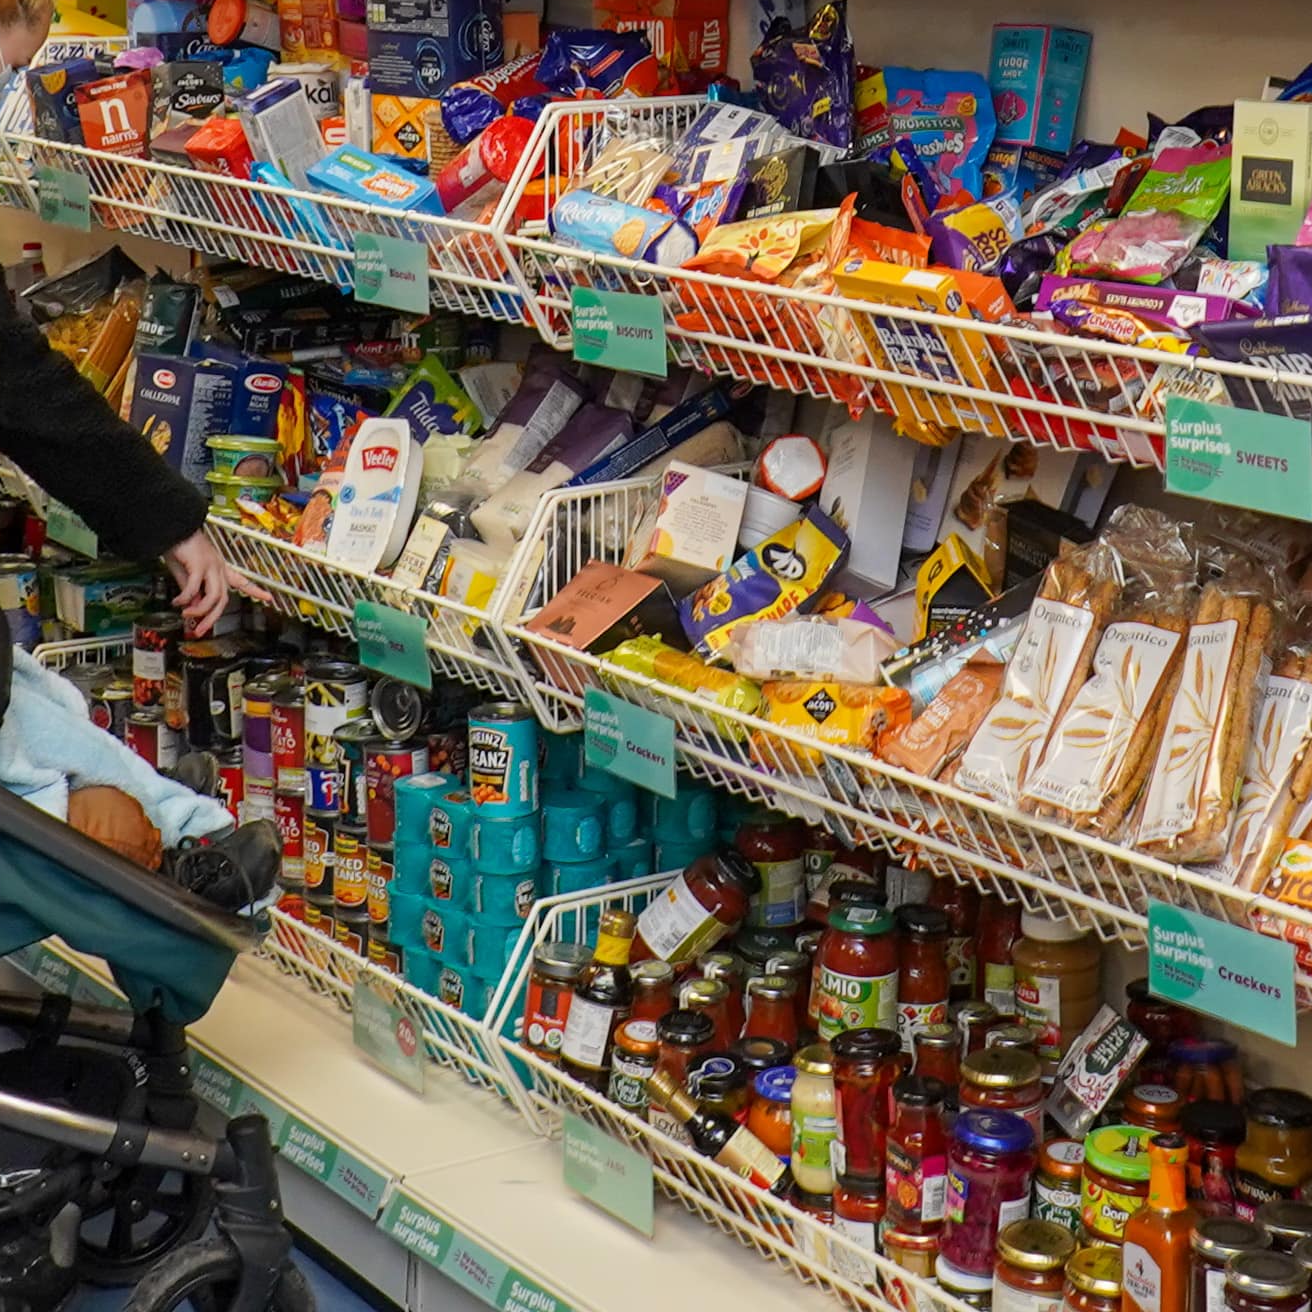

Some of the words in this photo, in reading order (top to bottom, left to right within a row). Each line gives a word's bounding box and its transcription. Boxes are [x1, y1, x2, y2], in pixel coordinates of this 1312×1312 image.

[701, 19, 721, 71] OATIES
[998, 55, 1029, 70] FUDGE
[98, 97, 131, 135] n
[892, 114, 962, 131] DRUMSTICK
[101, 128, 140, 147] nairn's
[560, 199, 595, 224] Rich
[574, 304, 608, 321] Surplus
[575, 316, 615, 334] surprises
[1089, 313, 1135, 337] Crunchie
[616, 325, 654, 341] BISCUITS
[408, 390, 441, 432] Tilda
[1170, 419, 1223, 437] Surplus
[1170, 434, 1231, 456] surprises
[362, 447, 396, 471] VeeTee
[1236, 449, 1289, 473] SWEETS
[1033, 603, 1082, 631] Organico
[1104, 627, 1170, 649] Organico
[625, 739, 666, 768] Crackers
[1152, 925, 1206, 950] Surplus
[1153, 941, 1215, 970] surprises
[1217, 966, 1282, 1000] Crackers
[289, 1124, 326, 1155] Surplus
[285, 1140, 327, 1177] surprises
[399, 1204, 442, 1237] Surplus
[391, 1220, 441, 1259] surprises
[510, 1280, 557, 1312] Surplus
